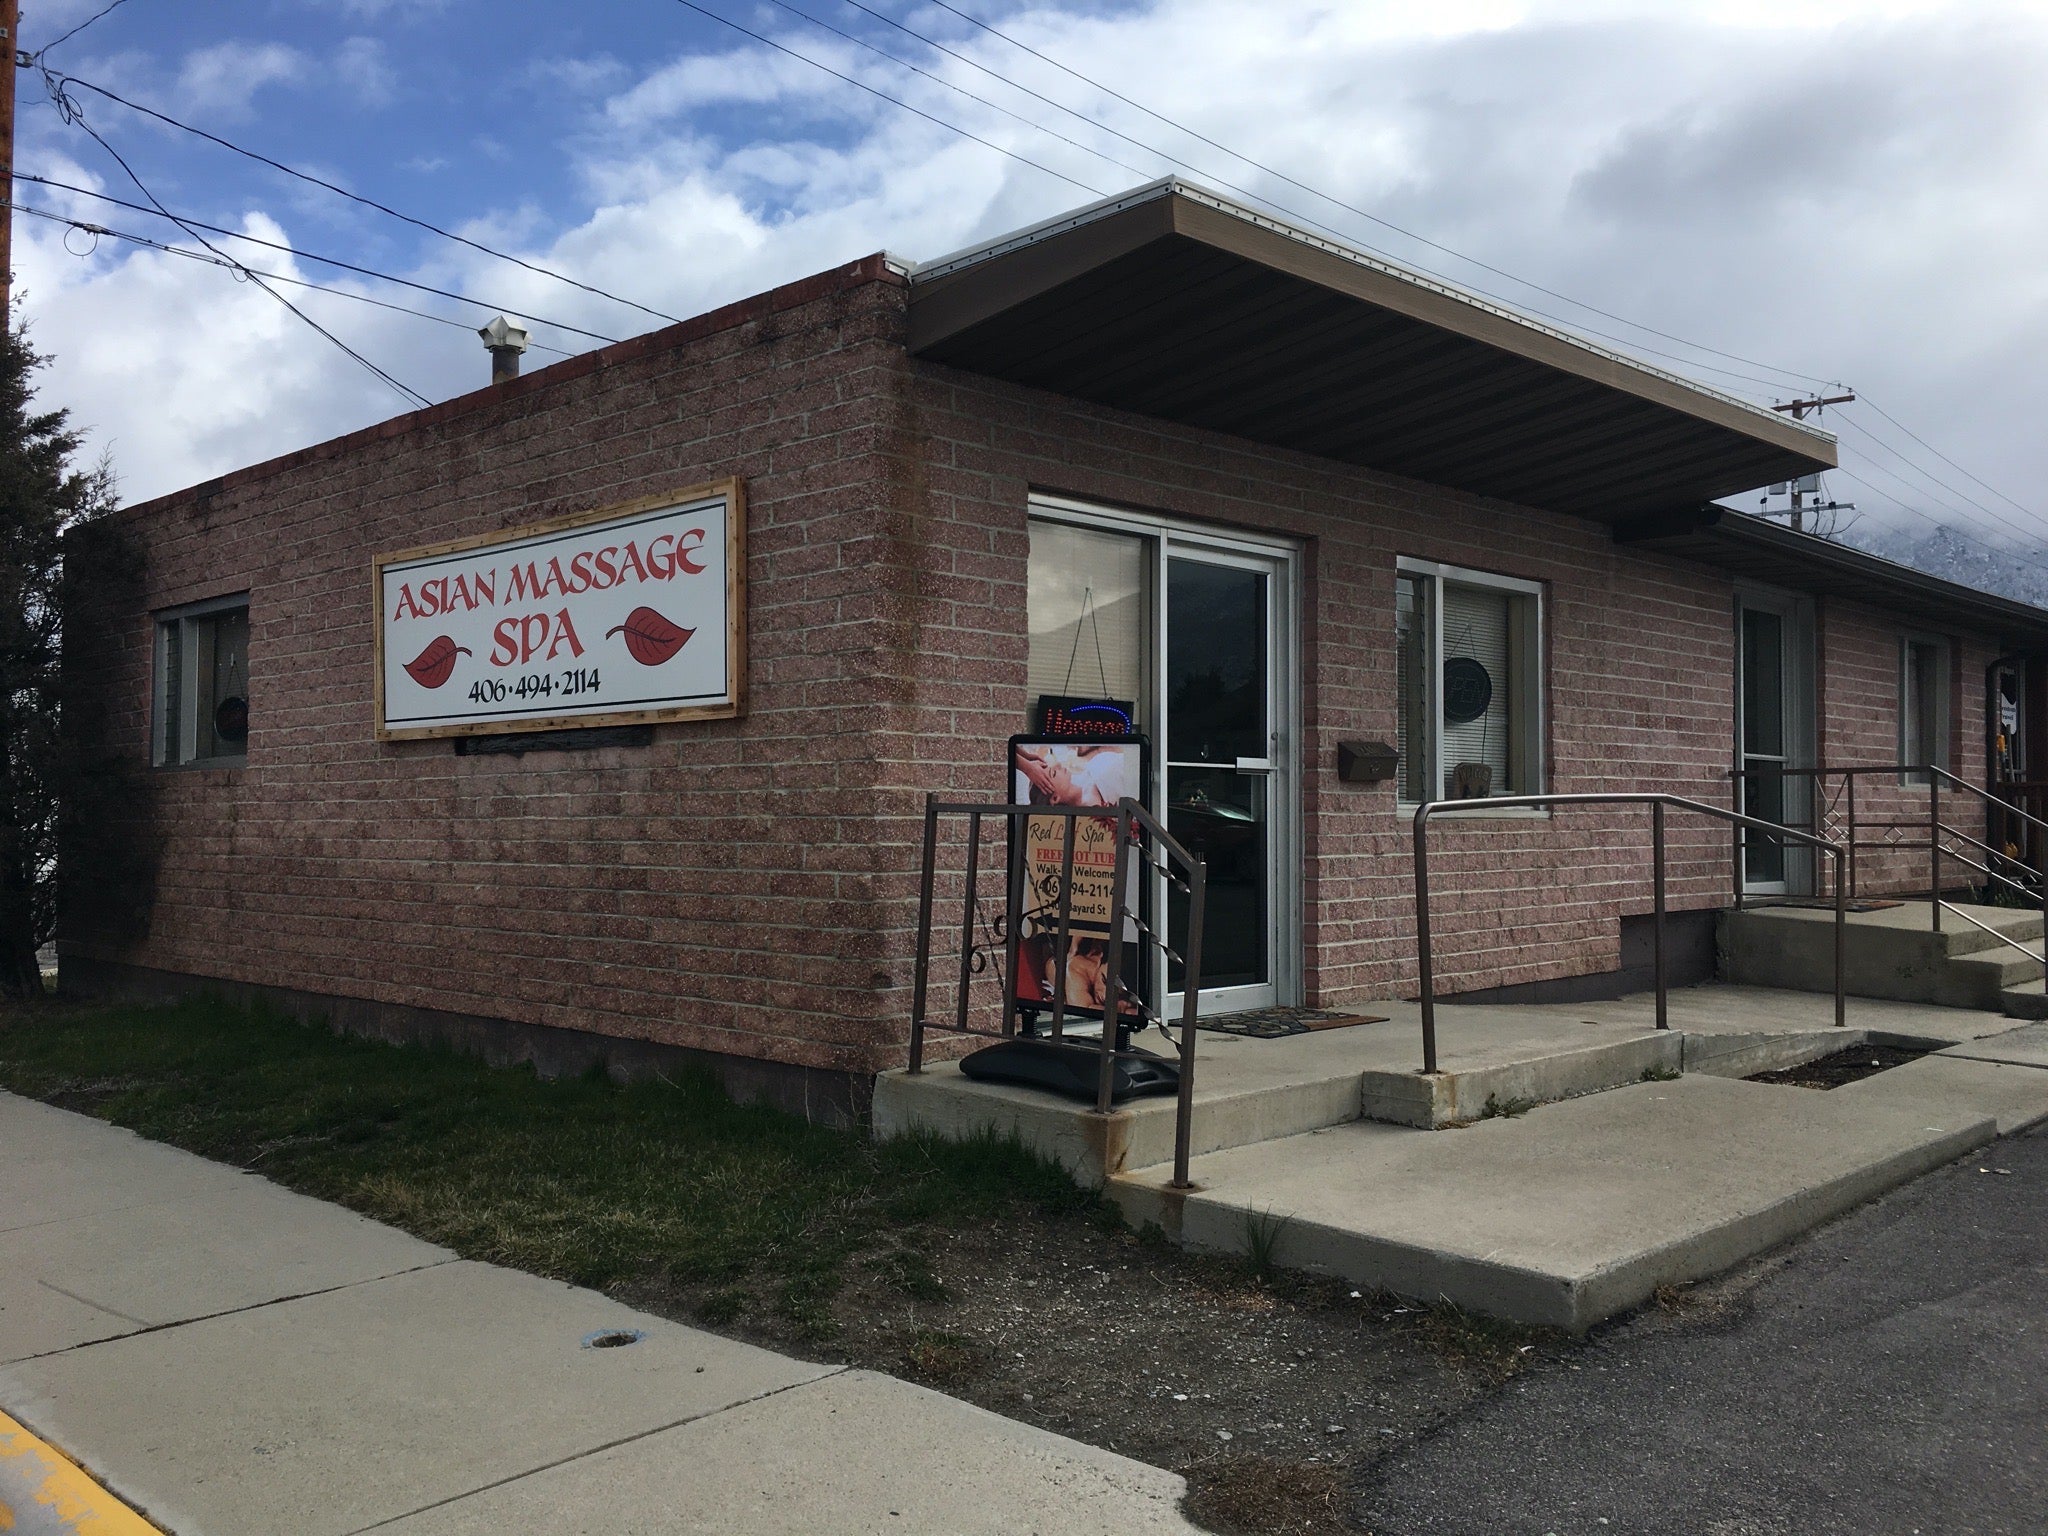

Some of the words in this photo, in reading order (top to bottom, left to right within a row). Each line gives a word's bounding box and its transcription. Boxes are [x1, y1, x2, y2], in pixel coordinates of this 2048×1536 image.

[393, 568, 496, 622] ASIAN
[504, 528, 708, 606] MASSAGE
[489, 607, 586, 667] SPA
[1029, 820, 1056, 842] Red
[1054, 822, 1082, 842] Lf
[1081, 824, 1104, 851] Spa
[1036, 848, 1064, 862] FREE
[1072, 850, 1091, 863] OT
[1093, 852, 1115, 864] TUB
[1036, 863, 1063, 875] Walk-
[1069, 902, 1096, 916] ayard
[1097, 904, 1106, 915] St
